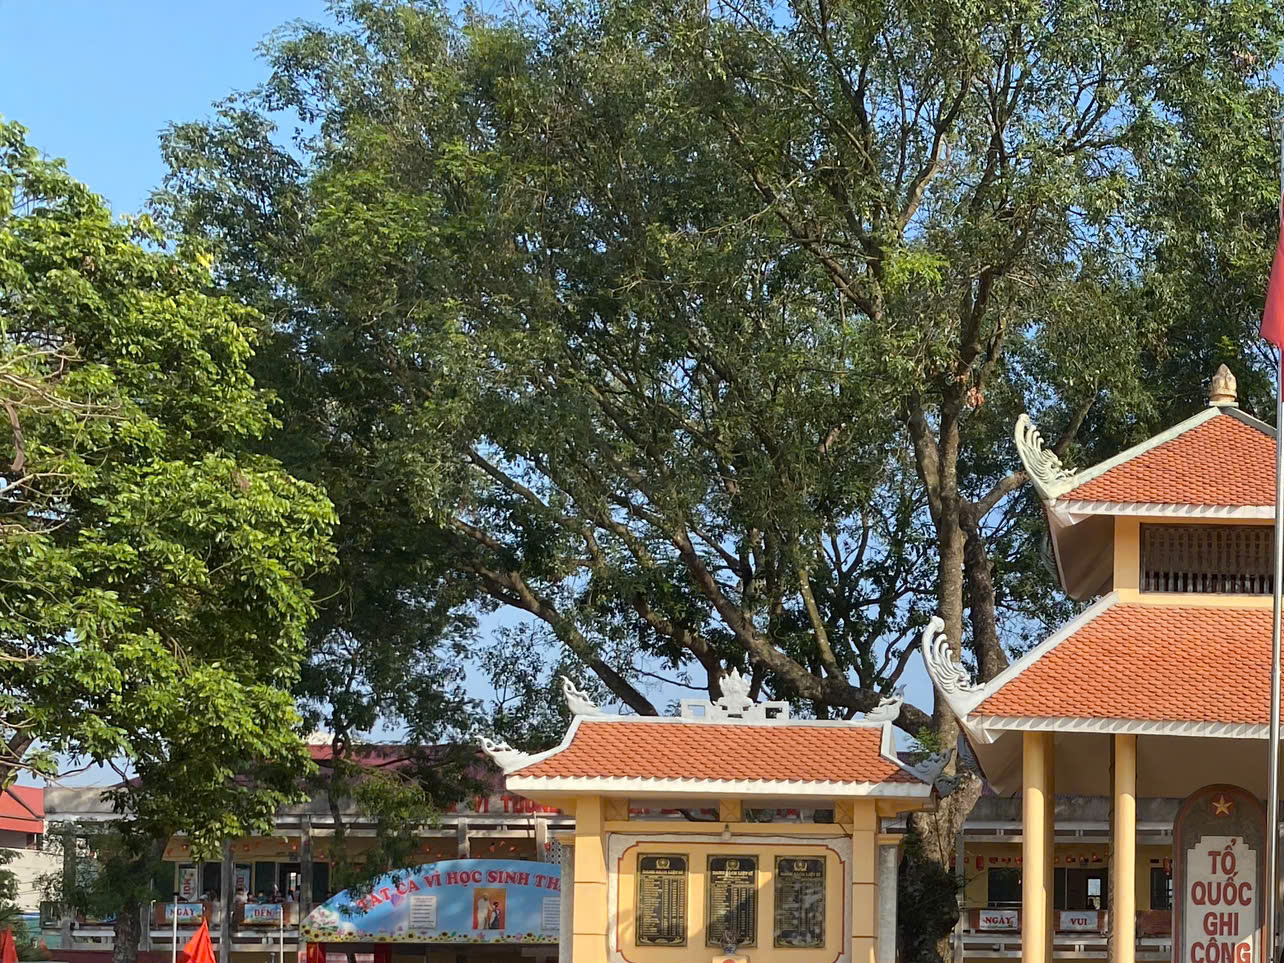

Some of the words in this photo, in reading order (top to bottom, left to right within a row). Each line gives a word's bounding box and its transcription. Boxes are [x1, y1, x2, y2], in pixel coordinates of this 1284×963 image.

[1208, 838, 1237, 875] TỔ
[447, 871, 482, 887] HỌC
[487, 869, 530, 885] SINH
[535, 874, 561, 892] TH
[1191, 872, 1252, 906] QUỐC
[1070, 918, 1088, 926] VUI
[1203, 912, 1239, 936] GHI
